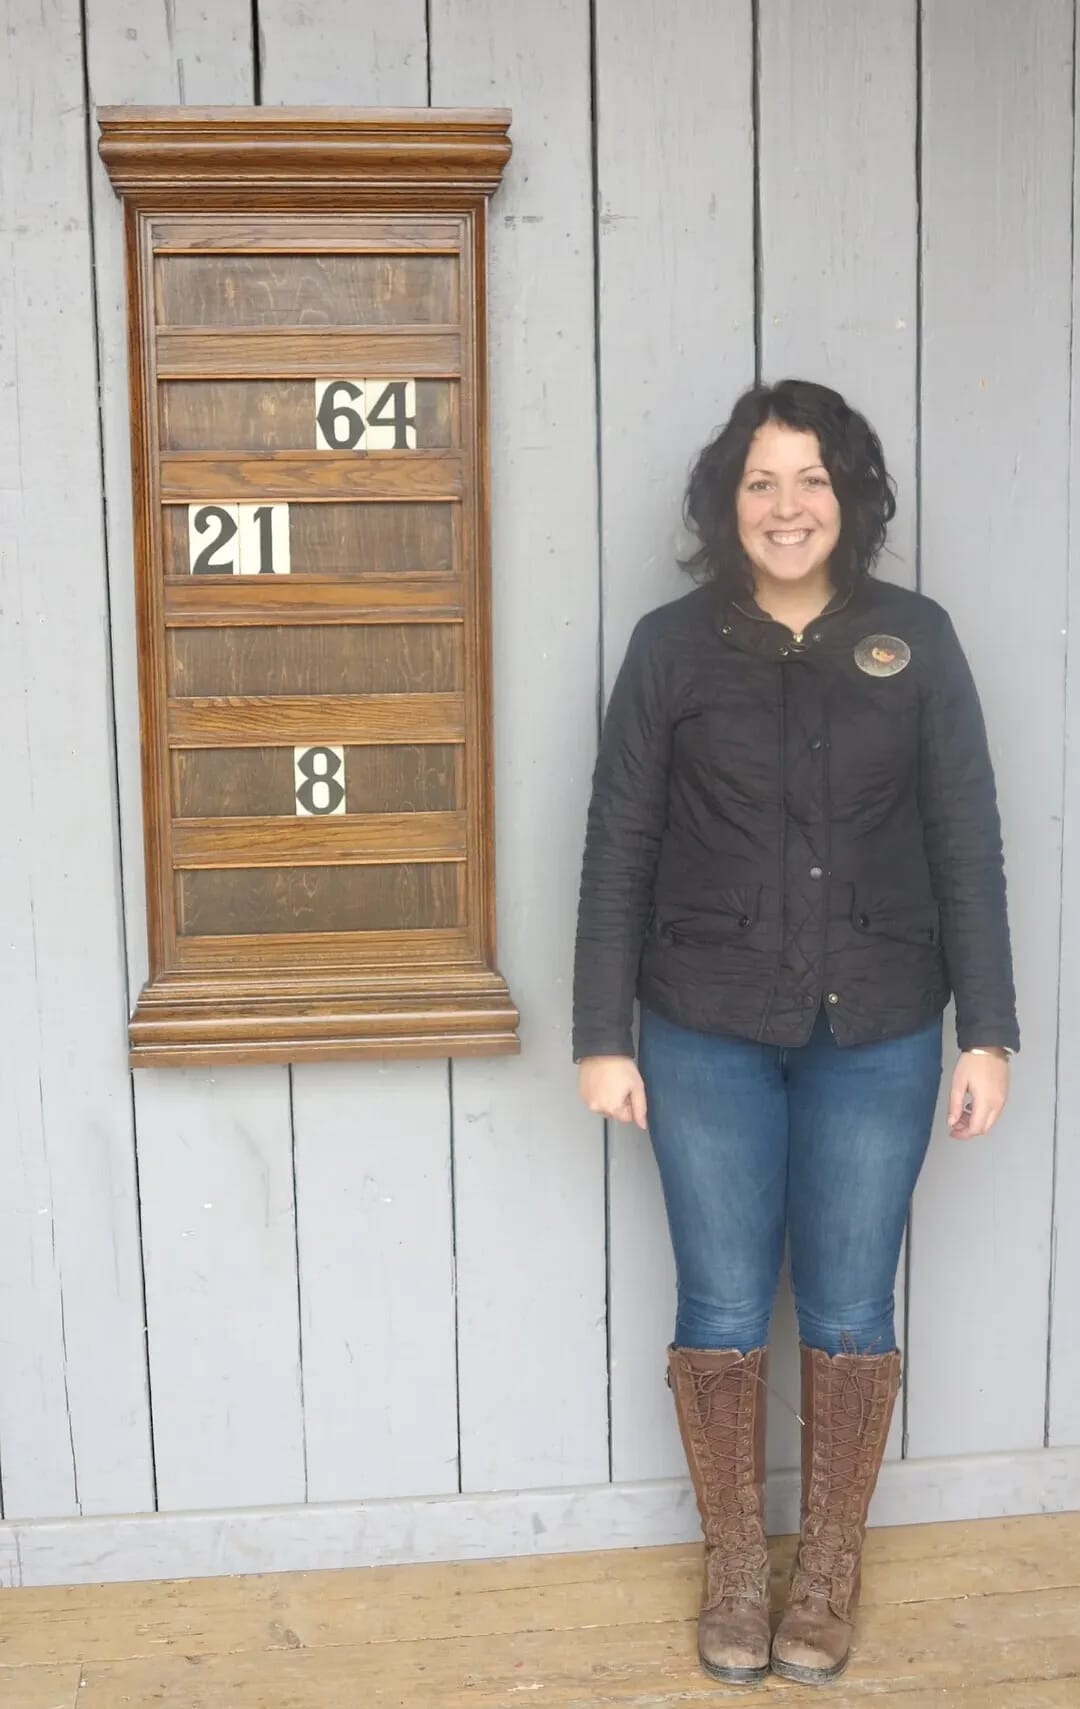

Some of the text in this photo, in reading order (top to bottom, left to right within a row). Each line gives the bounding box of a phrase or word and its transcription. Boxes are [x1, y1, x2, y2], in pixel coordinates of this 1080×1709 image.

[316, 381, 416, 449] 64
[192, 505, 275, 575] 21
[296, 746, 345, 815] 8
